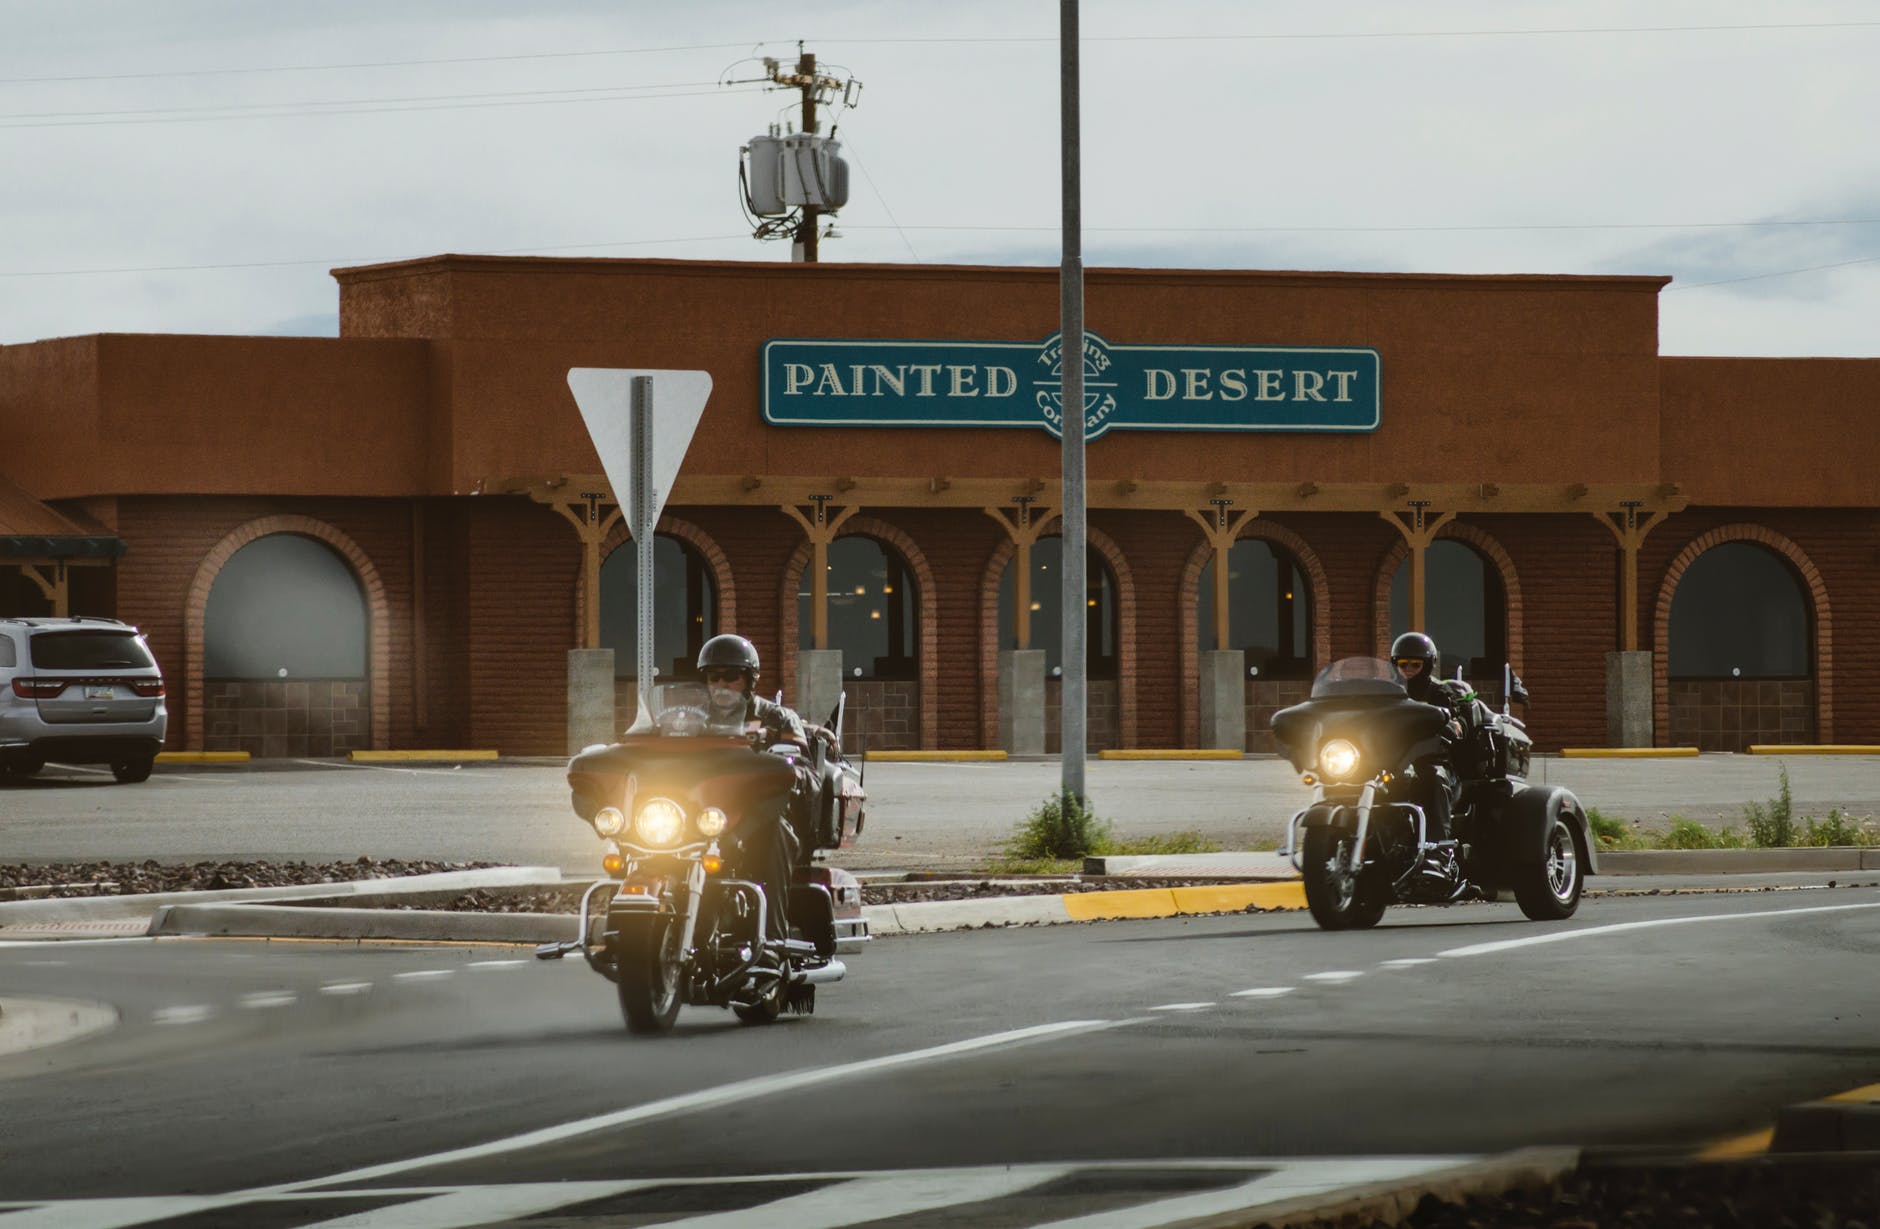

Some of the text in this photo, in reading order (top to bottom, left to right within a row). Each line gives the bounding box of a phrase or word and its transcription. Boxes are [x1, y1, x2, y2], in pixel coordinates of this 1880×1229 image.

[1037, 340, 1112, 371] Tring
[783, 363, 1358, 402] PAINTED DESERT
[1036, 390, 1117, 428] Coany
